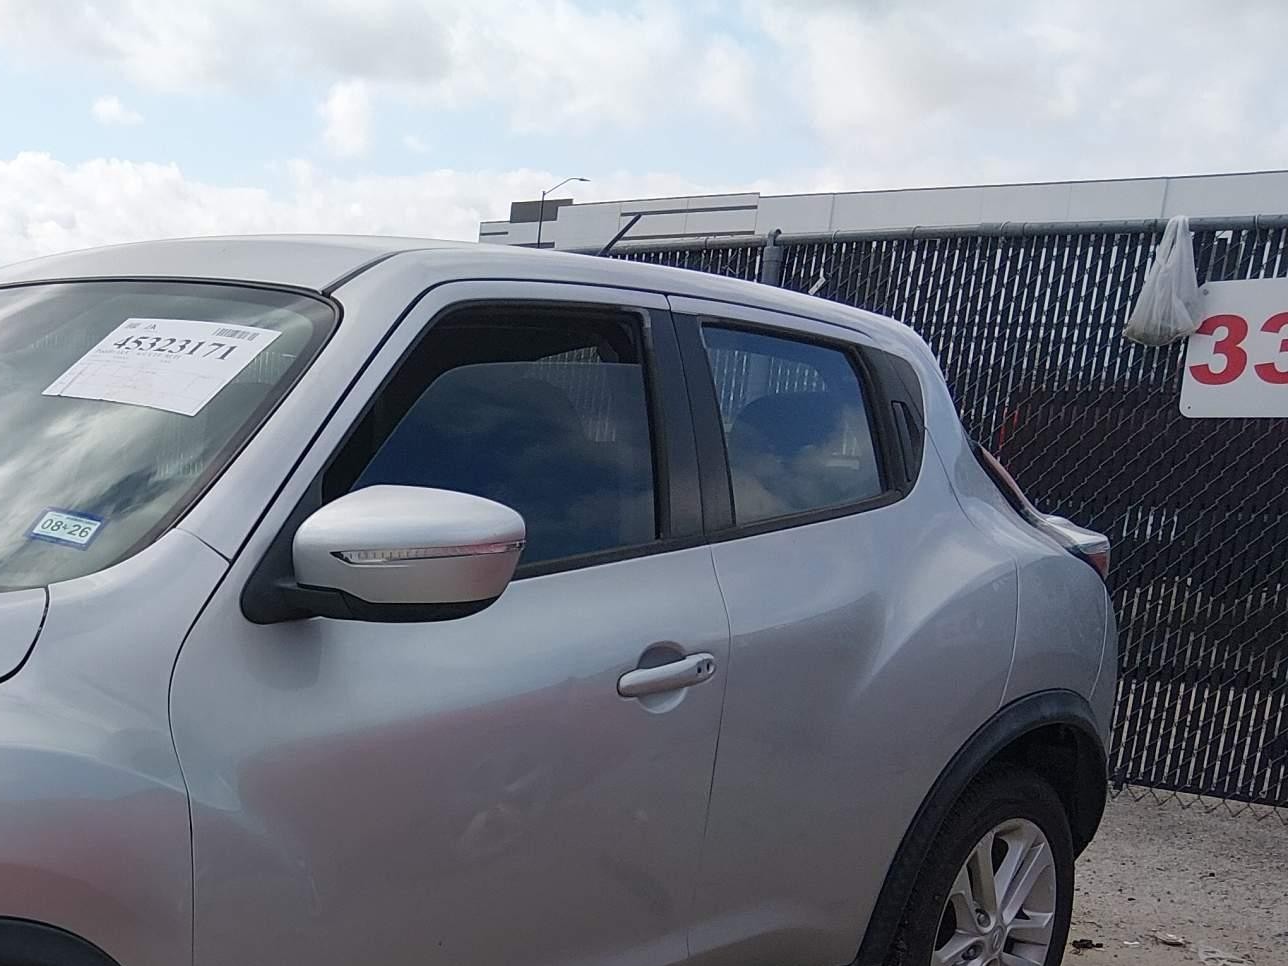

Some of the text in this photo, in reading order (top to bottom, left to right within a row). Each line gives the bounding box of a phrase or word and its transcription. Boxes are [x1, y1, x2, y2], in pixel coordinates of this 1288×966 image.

[113, 335, 238, 360] 45323171
[41, 518, 92, 538] 08 26
